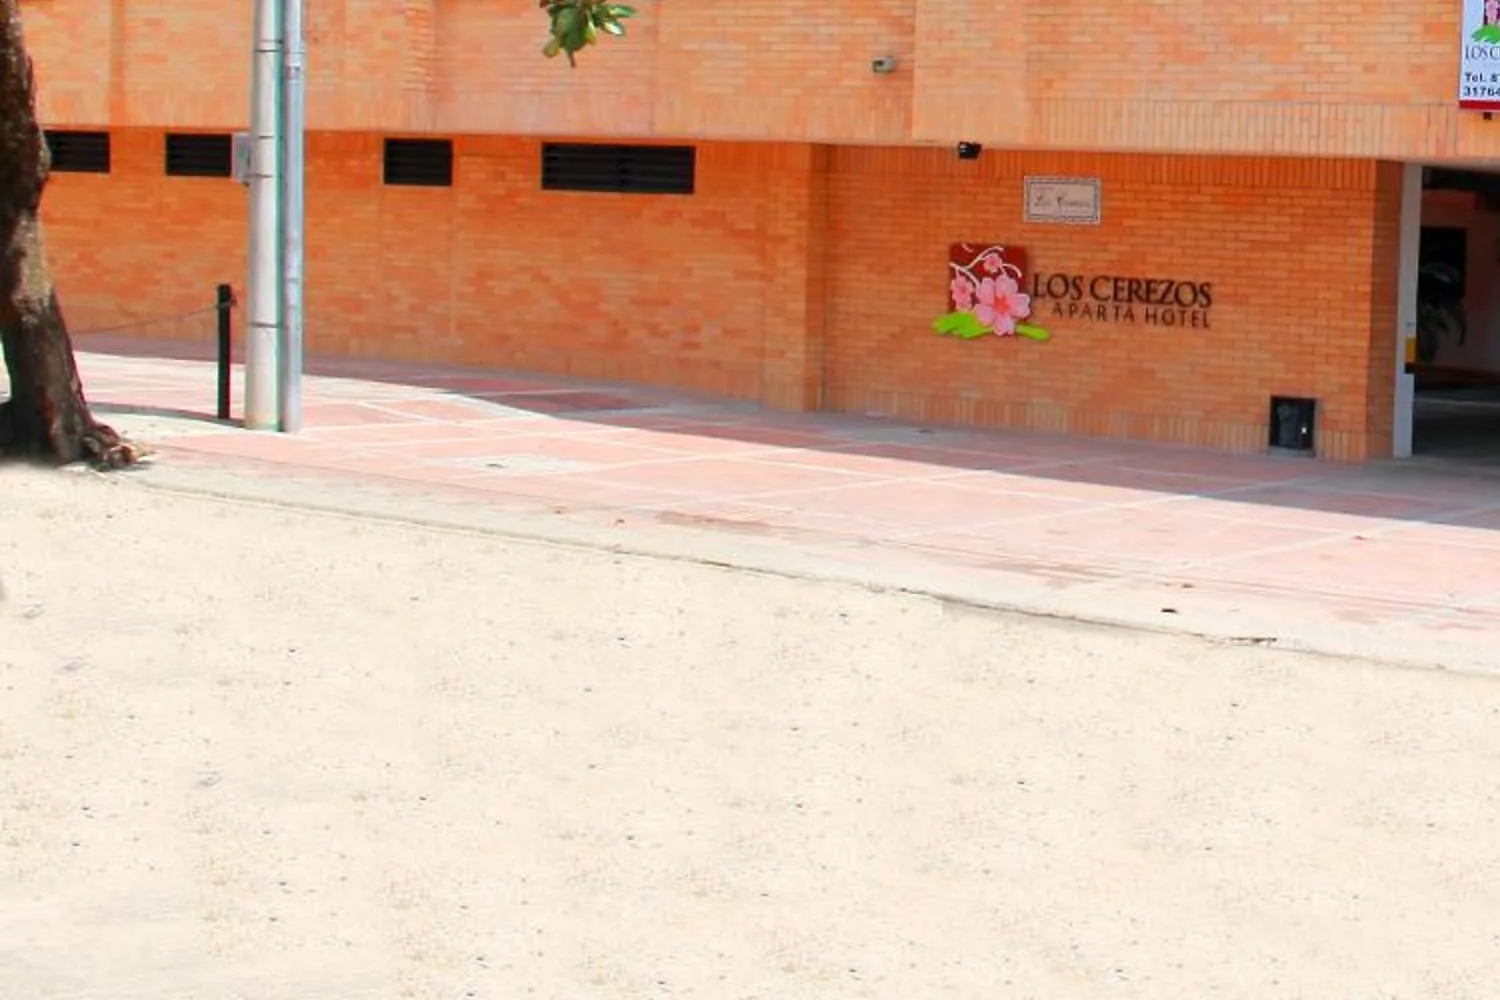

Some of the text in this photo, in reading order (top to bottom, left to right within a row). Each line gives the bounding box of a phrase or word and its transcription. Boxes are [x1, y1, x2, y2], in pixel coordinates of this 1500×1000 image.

[1465, 45, 1489, 60] LOS
[1465, 71, 1486, 83] Tel.
[1033, 273, 1212, 309] LOS CEREZOS
[1052, 301, 1211, 329] APARTA HOTEL
